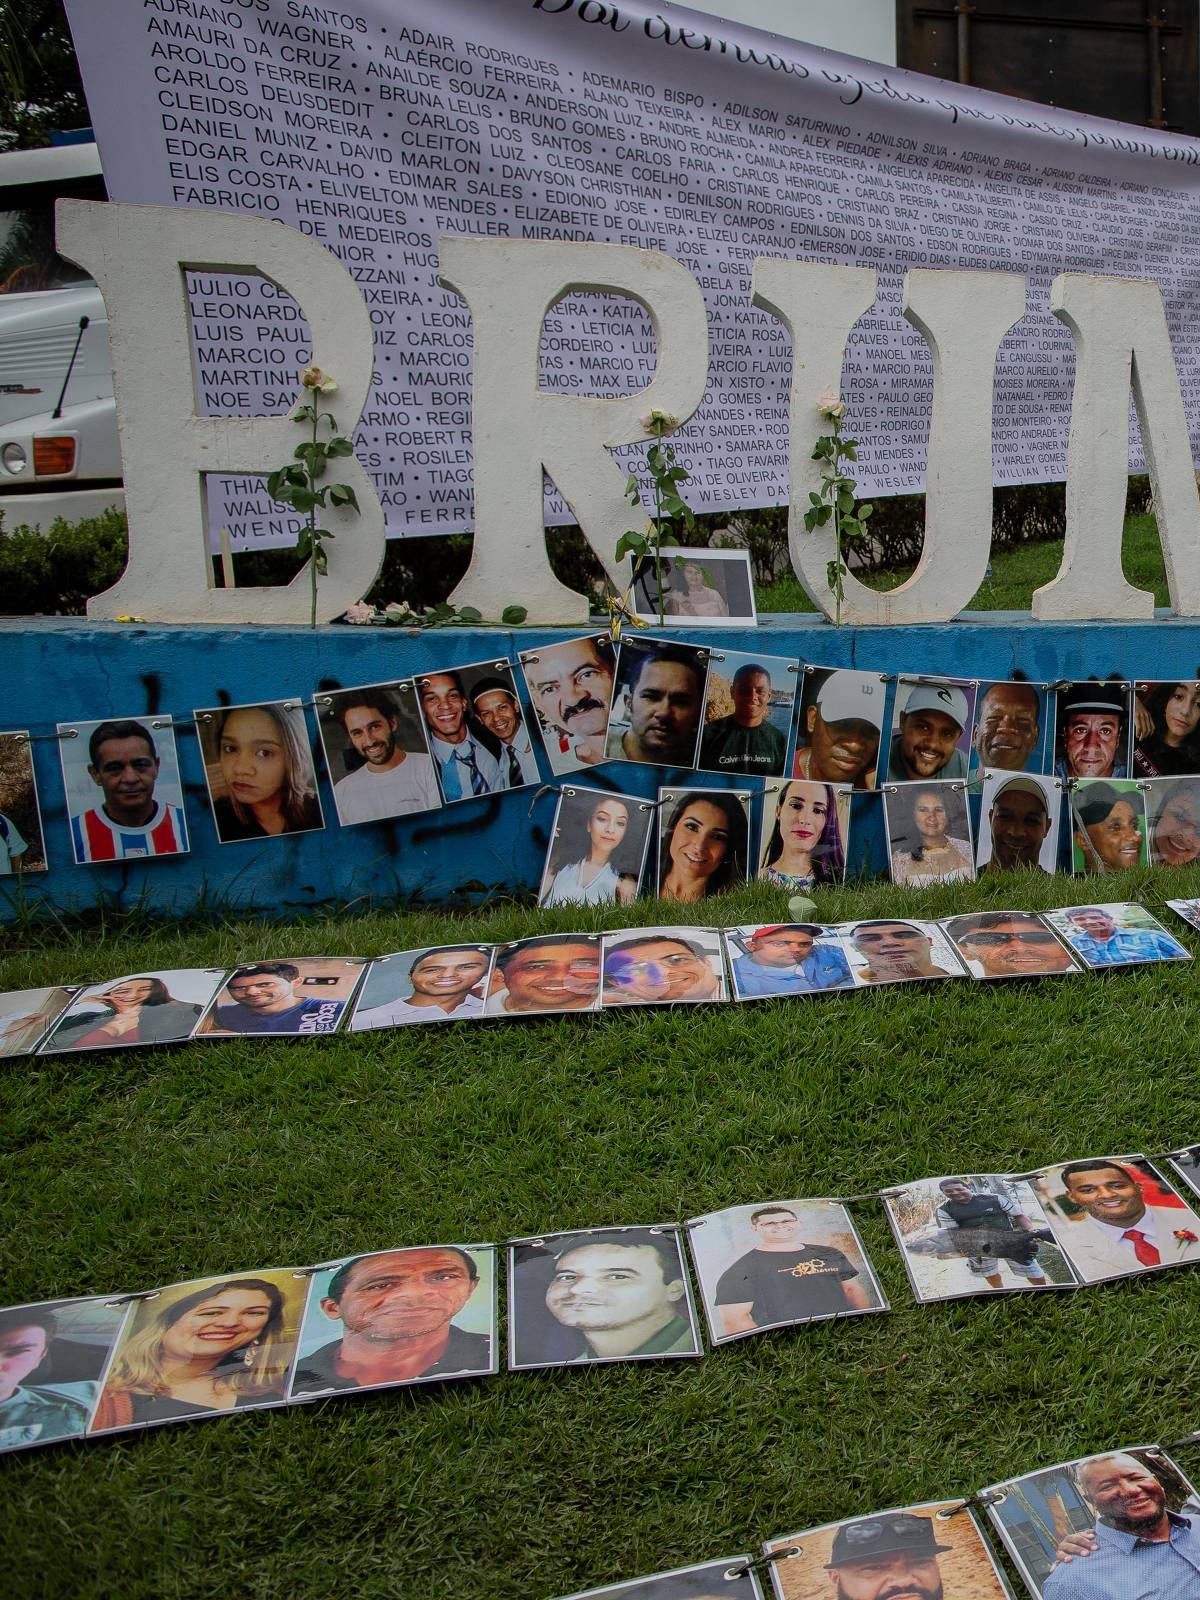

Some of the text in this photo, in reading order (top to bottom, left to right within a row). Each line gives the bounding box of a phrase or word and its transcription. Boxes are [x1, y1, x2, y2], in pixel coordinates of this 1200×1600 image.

[144, 0, 242, 29] ADRIANO
[257, 17, 355, 51] WAGNER
[384, 45, 472, 75] ALAÉRCIO
[484, 65, 563, 94] FERREIRA
[584, 88, 629, 109] ALANO
[635, 99, 694, 122] TEIXEIRA
[712, 116, 742, 132] ALEX
[749, 123, 785, 141] MARIO
[802, 134, 831, 149] ALEX
[836, 141, 880, 159] PIEDADE
[287, 1, 367, 33] SANTOS
[399, 27, 455, 52] ADAIR
[465, 42, 559, 76] RODRIGUES
[583, 71, 655, 98] ADEMARIO
[664, 89, 704, 108] BISPO
[723, 102, 778, 123] ADILSON
[785, 115, 851, 137] SATURNINO
[866, 132, 918, 151] ADNILSON
[922, 143, 947, 157] SILVA
[960, 151, 1000, 166] ADRIANO
[1004, 159, 1031, 171] BRAGA
[147, 16, 975, 189] AMAURI DA CRUZ ANAILDE SOUZA ANDERSON LUIZ ANDRE ALMEIDA ANDREA FERREIRA ANGELICA APARECIDA
[151, 41, 848, 181] AROLDO FERREIRA BRUNA LELIS BRUNO GOMES BRUNO ROCHA CAMILA APARECIDA
[154, 66, 248, 96] CARLOS
[261, 84, 374, 119] DEUSDEDIT
[407, 111, 479, 135] CARLOS
[488, 124, 522, 143] DOS
[531, 132, 592, 154] SANTOS
[616, 146, 672, 166] CARLOS
[680, 157, 716, 174] FARIA
[733, 166, 779, 184] CARLOS
[785, 175, 840, 194] HENRIQUE
[855, 187, 895, 203] CARLOS
[900, 194, 940, 209] PEREIRA
[987, 208, 1018, 221] REGINA
[158, 90, 920, 220] CLEIDSON MOREIRA CLEITON LUIZ CLEOSANE COELHO CRISTIANE CAMPOS CRISTIANO BRAZ
[162, 114, 910, 232] DANIEL MUNIZ DAVID MARLON DAVYSON CHRISTHIAN DENILSON RODRIGUES DENNIS DA SILVA
[165, 138, 248, 163] EDGAR
[260, 150, 364, 179] CARVALHO
[388, 170, 457, 192] EDIMAR
[467, 180, 523, 199] SALES
[546, 189, 606, 209] EDIONIO
[614, 200, 648, 215] JOSE
[664, 206, 717, 224] EDIRLEY
[724, 214, 775, 231] CAMPOS
[790, 222, 845, 239] EDNILSON
[851, 229, 872, 242] DOS
[877, 233, 915, 247] SANTOS
[927, 239, 958, 252] EDSON
[962, 243, 1011, 258] RODRIGUES
[1065, 255, 1105, 269] RODRIGUES
[169, 162, 219, 182] ELIS
[228, 169, 302, 192] COSTA
[320, 180, 418, 207] ELIVELTOM
[423, 194, 496, 216] MENDES
[515, 205, 599, 227] ELIZABETE
[604, 215, 623, 229] DE
[628, 218, 686, 237] OLIVEIRA
[697, 227, 738, 243] ELIZEU
[742, 233, 795, 249] CARANJO
[859, 246, 886, 262] JOSE
[895, 249, 927, 263] ERIDIO
[930, 252, 951, 265] DIAS
[958, 257, 988, 269] EUDES
[989, 259, 1028, 274] CARDOSO
[173, 186, 708, 255] FABRICIO HENRIQUES FAULLER MIRANDA JOSE
[338, 224, 432, 248] MEDEIROS
[188, 279, 251, 298] JULIO
[194, 324, 244, 341] LUIS
[582, 322, 634, 336] LETICIA
[198, 347, 285, 364] MARCIO
[400, 352, 469, 366] MARCIO
[866, 349, 906, 360] MANOEL
[1027, 366, 1058, 376] AURELIO
[729, 377, 765, 388] XISTO
[1026, 379, 1060, 389] MOREIRA
[205, 392, 251, 407] NOE
[375, 392, 423, 406] NOEL
[719, 393, 761, 404] GOMES
[1012, 416, 1052, 427] MONTEIRO
[385, 431, 456, 446] ROBERT
[709, 425, 756, 437] SANDER
[875, 448, 914, 460] MENDES
[1003, 455, 1035, 465] WARLEY
[706, 456, 743, 469] TIAGO
[997, 467, 1039, 478] WILLIAN
[699, 486, 756, 502] WESLEY
